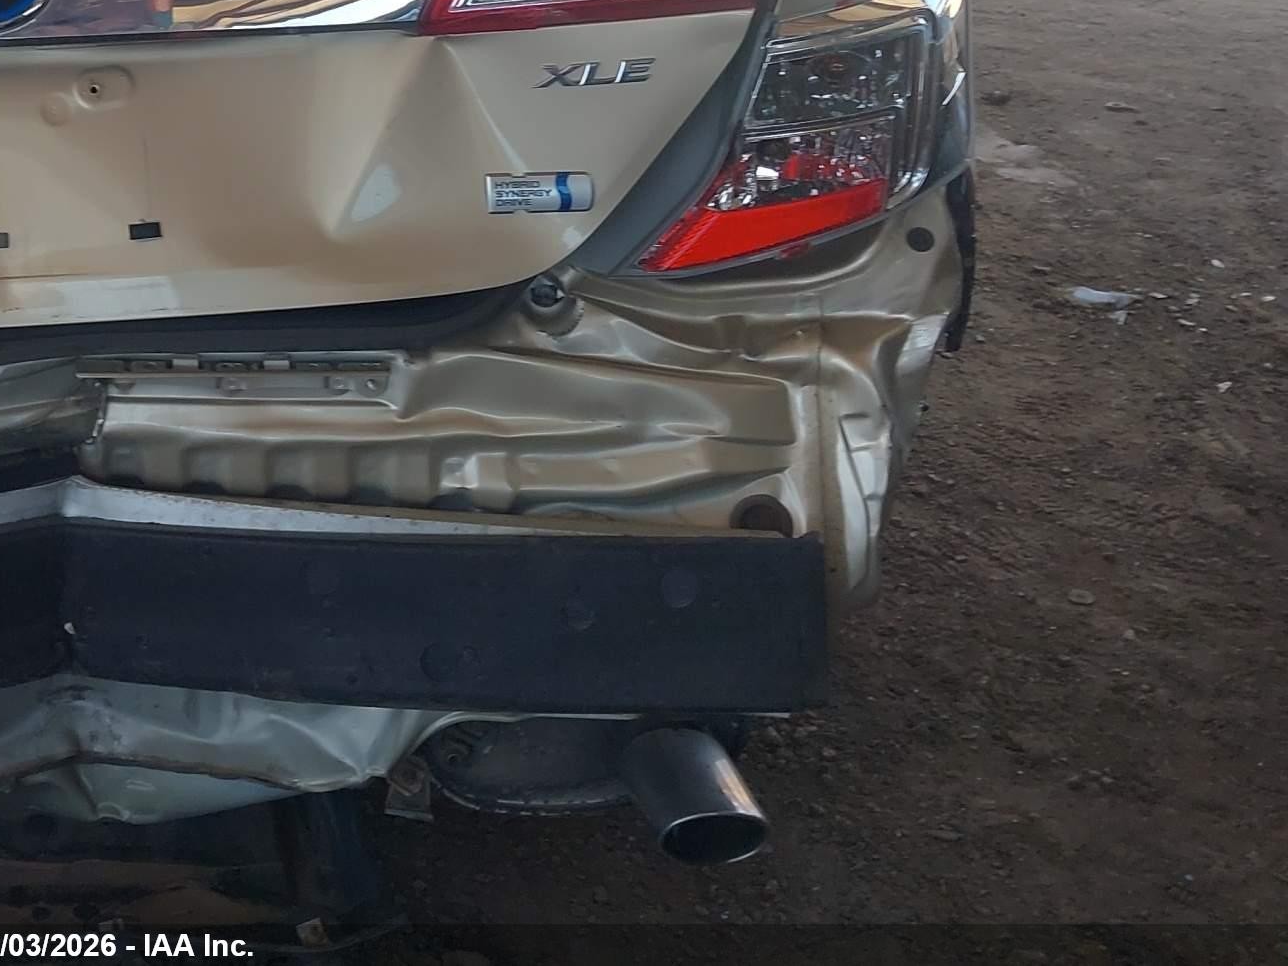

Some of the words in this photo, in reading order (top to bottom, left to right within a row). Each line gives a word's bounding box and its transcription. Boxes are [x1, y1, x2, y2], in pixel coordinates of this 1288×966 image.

[531, 57, 656, 89] XLE
[494, 180, 541, 189] HYBRID
[495, 189, 552, 198] SYNERGY
[495, 198, 533, 207] DRIVE
